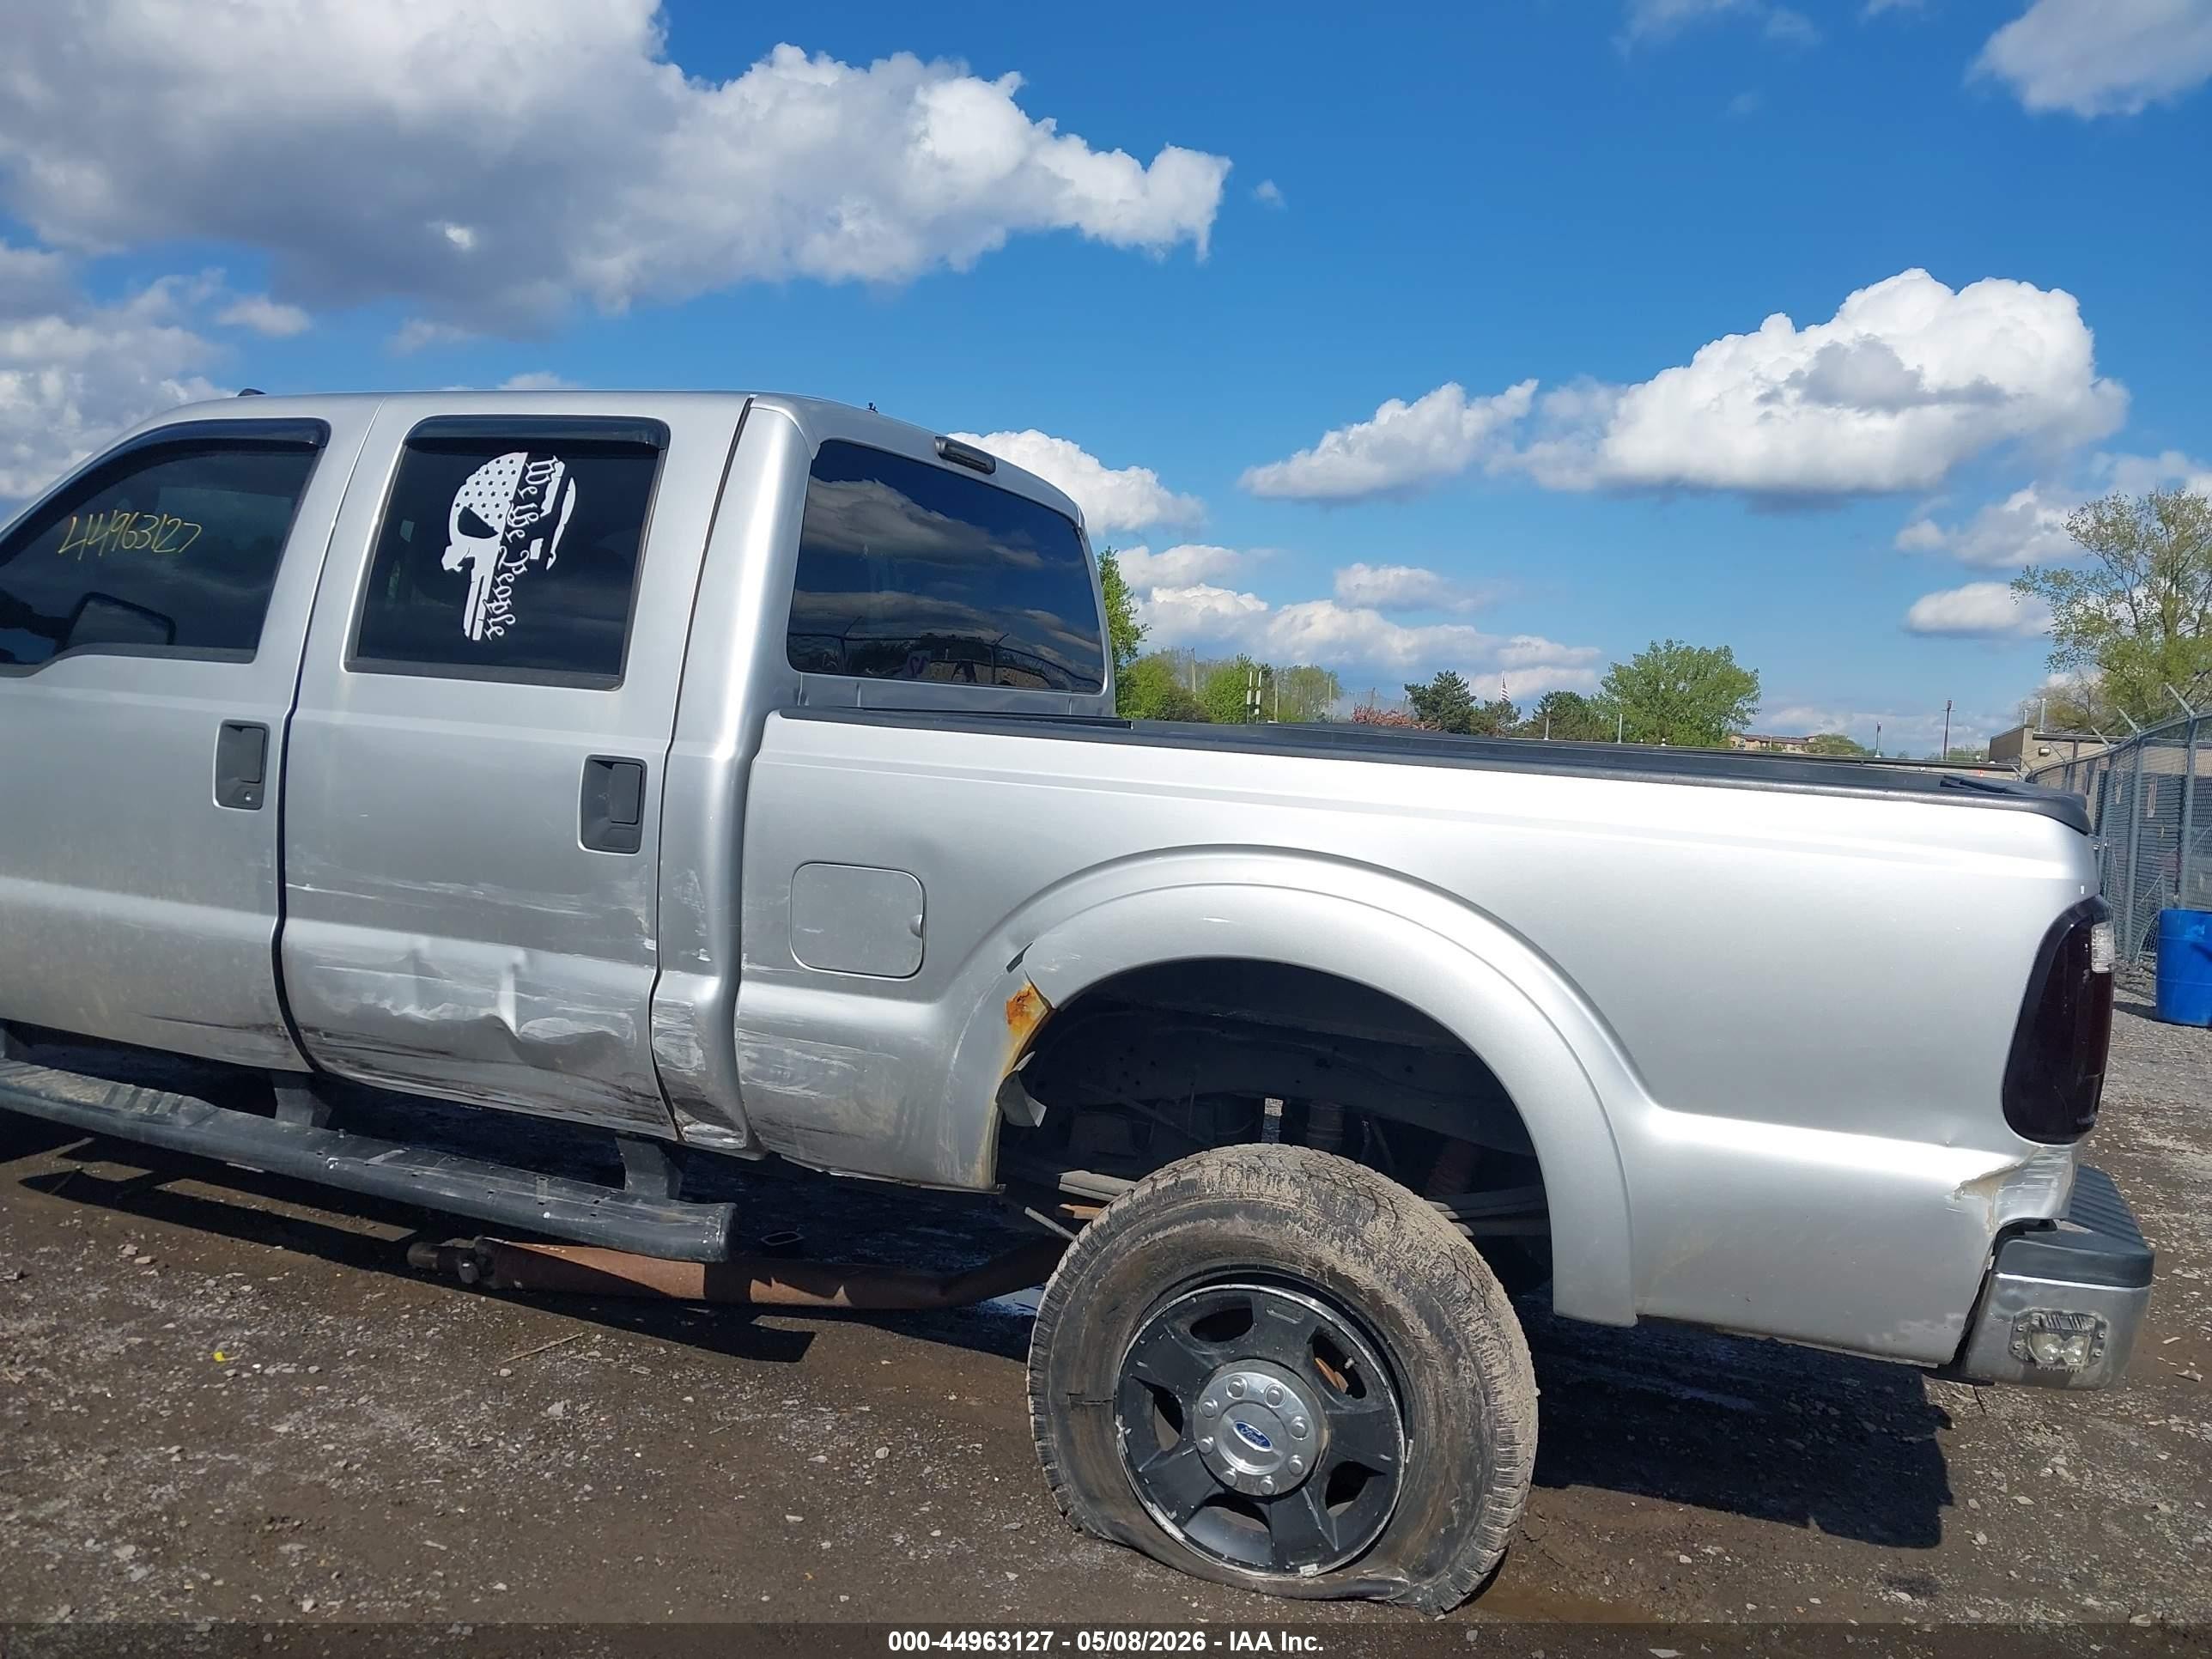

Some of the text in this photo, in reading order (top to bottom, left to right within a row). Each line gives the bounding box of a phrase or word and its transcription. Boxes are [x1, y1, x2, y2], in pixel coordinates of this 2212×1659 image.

[58, 509, 202, 560] 44963127
[483, 455, 558, 641] We the People
[1240, 1425, 1267, 1446] Ford
